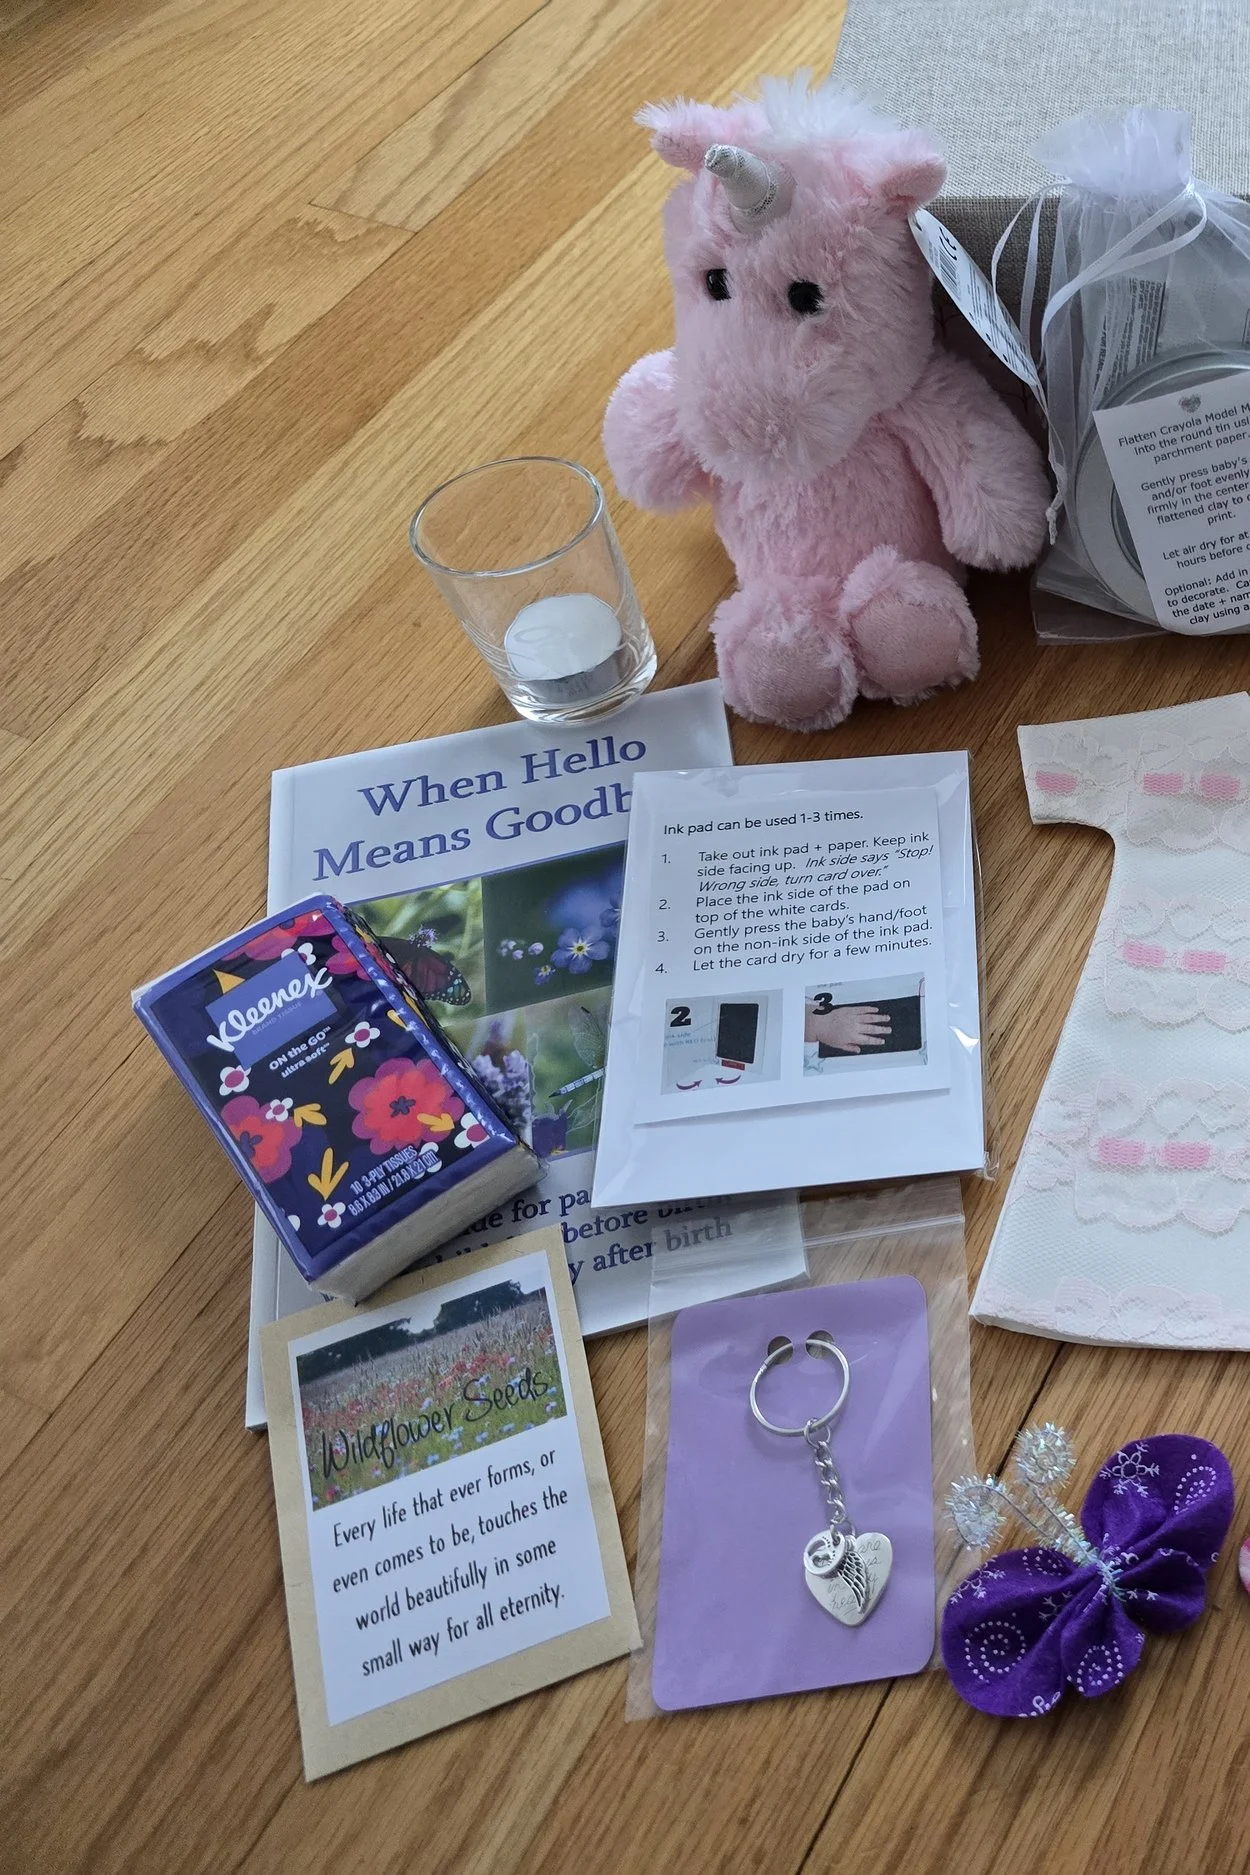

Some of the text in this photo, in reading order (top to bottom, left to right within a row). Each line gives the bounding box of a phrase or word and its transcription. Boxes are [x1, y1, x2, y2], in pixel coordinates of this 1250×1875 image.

[1118, 430, 1157, 448] Flatten
[1159, 417, 1203, 436] Crayola
[1204, 405, 1238, 424] Model
[1133, 443, 1157, 456] into
[1158, 437, 1178, 449] the
[1180, 425, 1213, 444] round
[1215, 423, 1231, 434] tin
[1152, 431, 1250, 465] parchment paper.
[1140, 475, 1176, 492] Gently
[1179, 467, 1209, 484] press
[1210, 456, 1248, 473] baby's
[1156, 504, 1205, 525] flattened
[1207, 499, 1229, 512] clay
[1231, 496, 1244, 506] to
[1206, 510, 1237, 527] print.
[1162, 548, 1181, 561] Let
[1182, 544, 1197, 556] air
[1199, 539, 1217, 551] dry
[1219, 535, 1236, 546] for
[1237, 530, 1250, 541] at
[1176, 555, 1207, 569] hours
[1208, 545, 1244, 561] before
[1164, 576, 1212, 597] Optional:
[1215, 569, 1236, 584] Add
[1237, 568, 1249, 578] in
[357, 735, 647, 817] When Hello
[312, 782, 634, 882] Means Goodb
[663, 810, 864, 837] Ink pad can be used 1-3 times.
[661, 831, 930, 864] 1. Take out ink pad paper. Keep ink
[696, 844, 934, 877] side facing up. Ink side says "Stop!
[658, 879, 911, 910] 2. Place the ink side of the pad on
[699, 864, 889, 893] Wrong side, turn card over."
[656, 905, 928, 943] 3. Gently press the baby's hand/foot
[695, 899, 850, 926] top of the white cards.
[693, 918, 933, 955] on the non-ink side of the ink pad.
[654, 937, 932, 974] 4. Let the card dry for a few minutes.
[206, 967, 333, 1053] Kleenex
[669, 1006, 692, 1028] 2
[812, 992, 834, 1016] 3
[269, 1054, 288, 1071] ON
[287, 1043, 308, 1059] the
[281, 1060, 306, 1078] ultra
[350, 1145, 418, 1195] 10 3-PLY TISSUES
[347, 1199, 364, 1216] 8.6
[366, 1187, 381, 1204] 8.3
[377, 1181, 391, 1196] IN
[391, 1168, 411, 1187] 21.8
[512, 1199, 551, 1223] for
[561, 1207, 648, 1244] before
[593, 1216, 734, 1272] after birth
[322, 1367, 549, 1479] Wildflower Seeds
[333, 1449, 556, 1548] Every life that ever forms, or
[332, 1484, 568, 1594] even comes to be, touches the
[355, 1539, 557, 1631] world beautifully in some
[361, 1582, 565, 1677] small way for all eternity.
